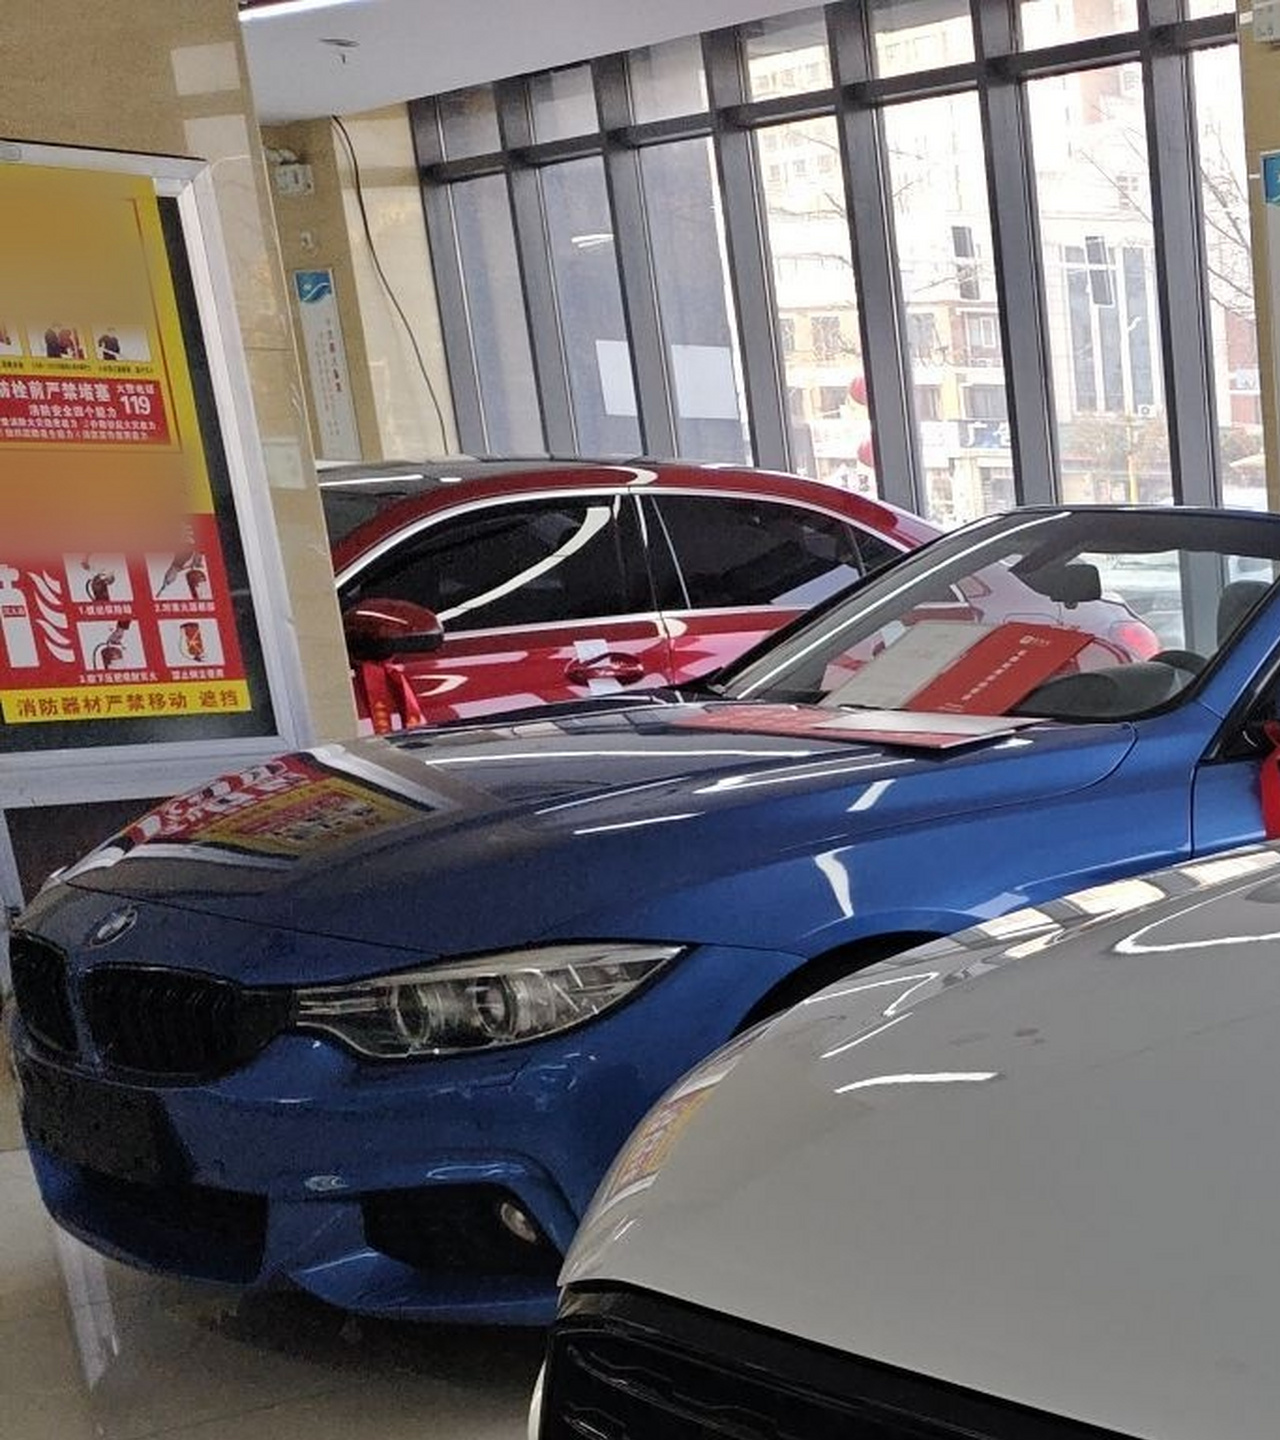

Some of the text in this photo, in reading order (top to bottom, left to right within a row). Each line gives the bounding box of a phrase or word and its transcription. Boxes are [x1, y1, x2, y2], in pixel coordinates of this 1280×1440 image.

[120, 395, 151, 415] 119
[17, 690, 239, 717] 消防器材严禁移动 遮挡
